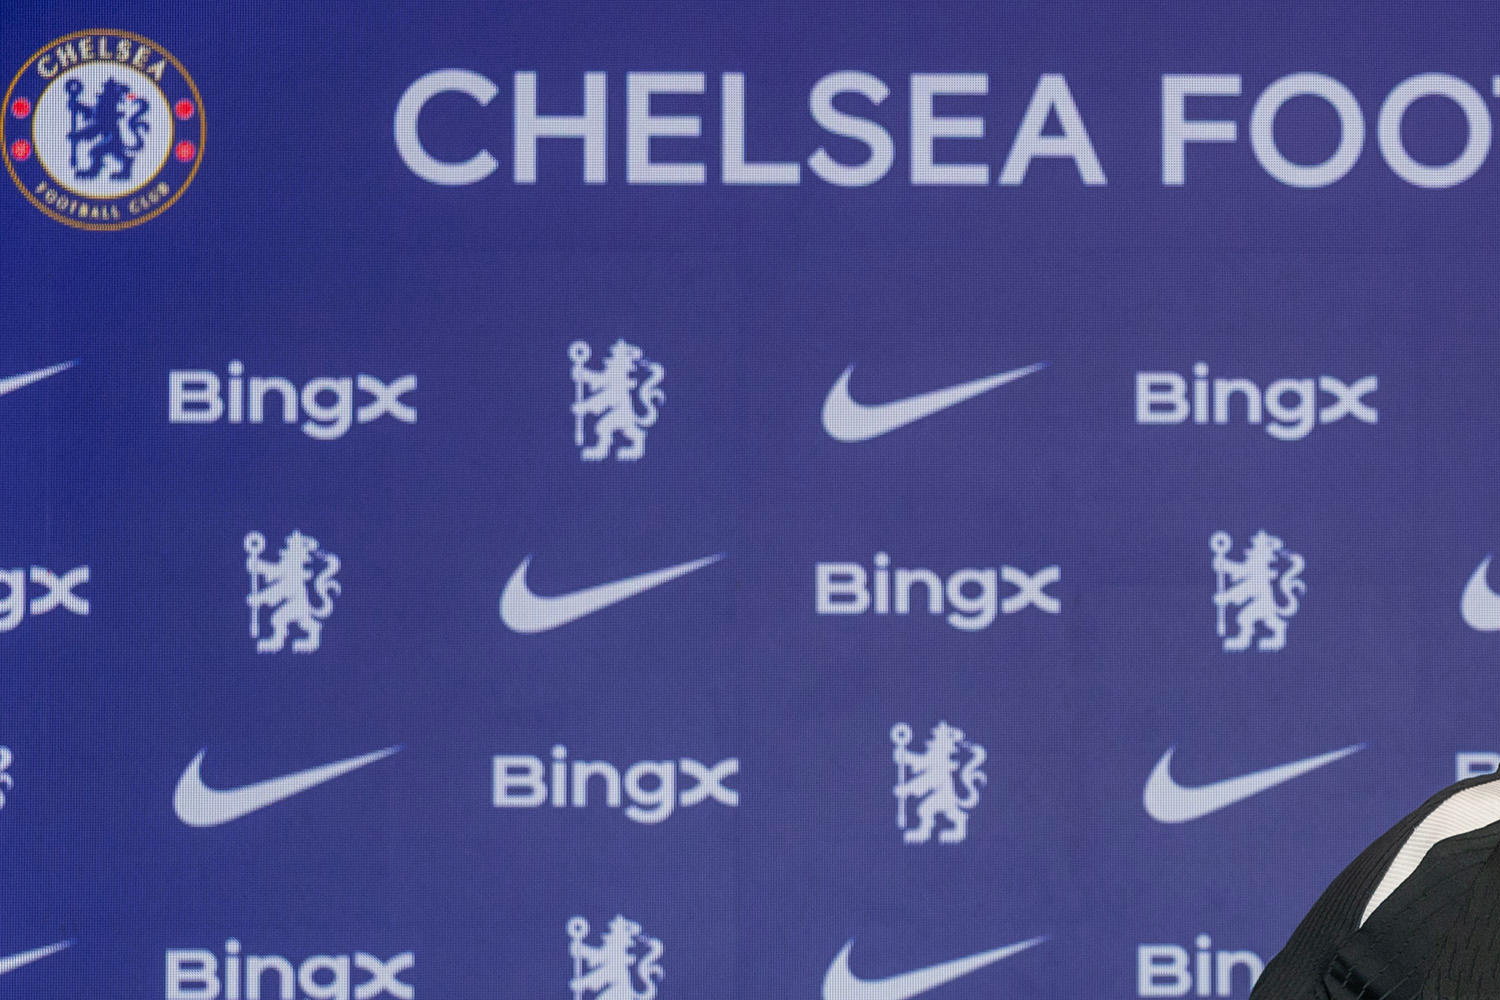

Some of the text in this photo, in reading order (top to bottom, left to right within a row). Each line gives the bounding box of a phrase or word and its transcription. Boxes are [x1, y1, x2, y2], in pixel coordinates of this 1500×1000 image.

[36, 36, 168, 82] CHELSEA
[393, 69, 1107, 187] CHELSEA
[1137, 932, 1265, 998] Bin
